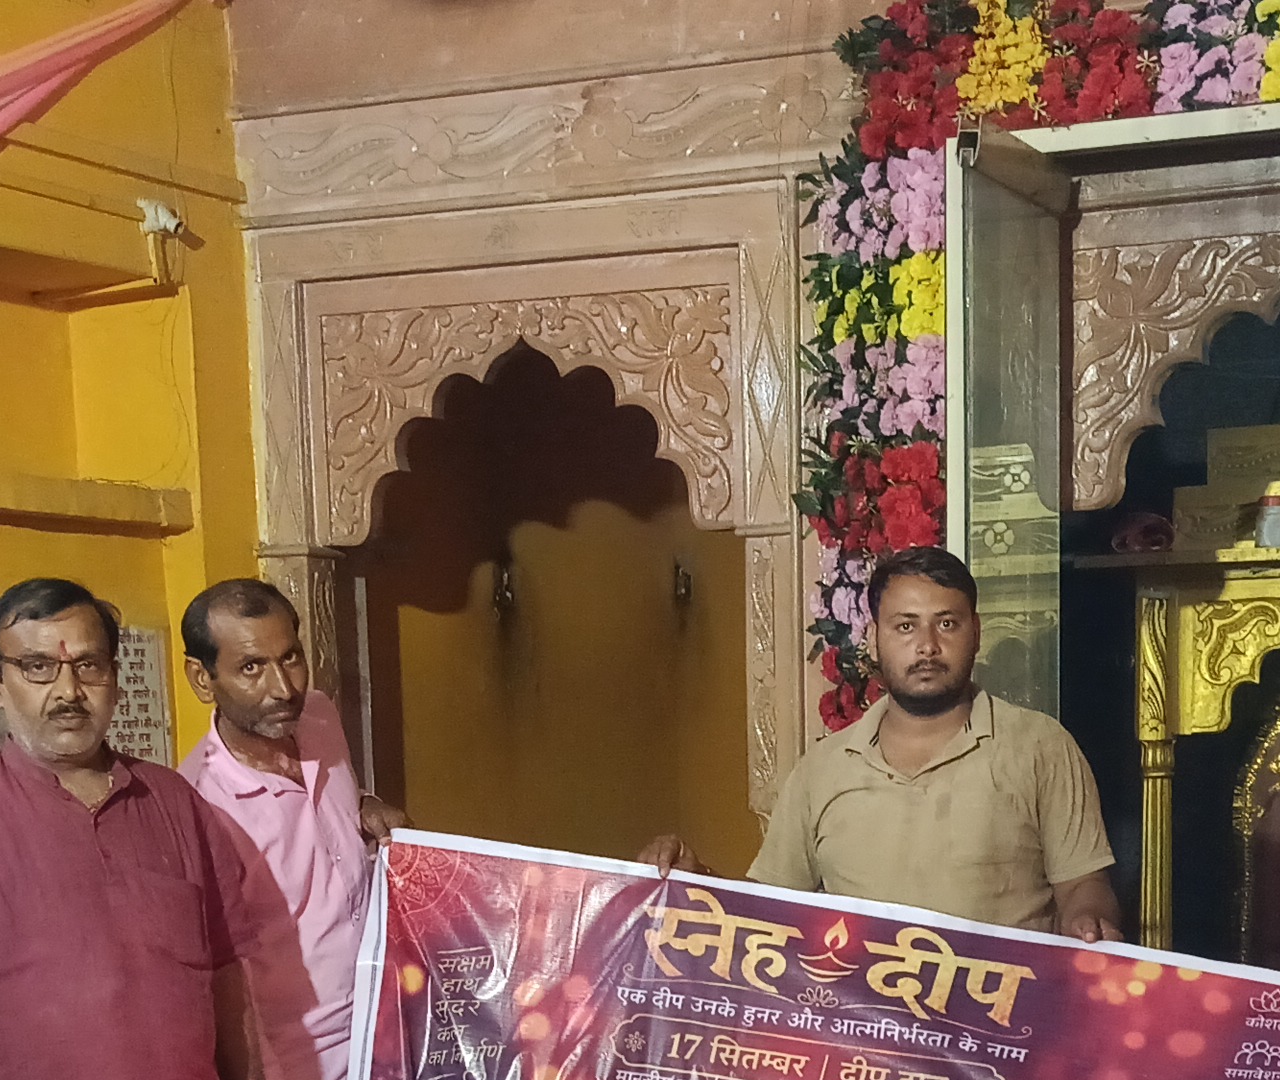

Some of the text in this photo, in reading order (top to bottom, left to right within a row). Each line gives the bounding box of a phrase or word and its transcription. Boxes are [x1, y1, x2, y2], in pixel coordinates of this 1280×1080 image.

[437, 954, 493, 975] सक्षम
[645, 887, 1038, 1028] स्नेह दीप
[617, 985, 1029, 1064] एक दीप उनके हुनर और आत्मनिर्भरता के नाम
[428, 1051, 446, 1067] का
[667, 1032, 702, 1061] 17
[710, 1037, 811, 1079] सितम्बर
